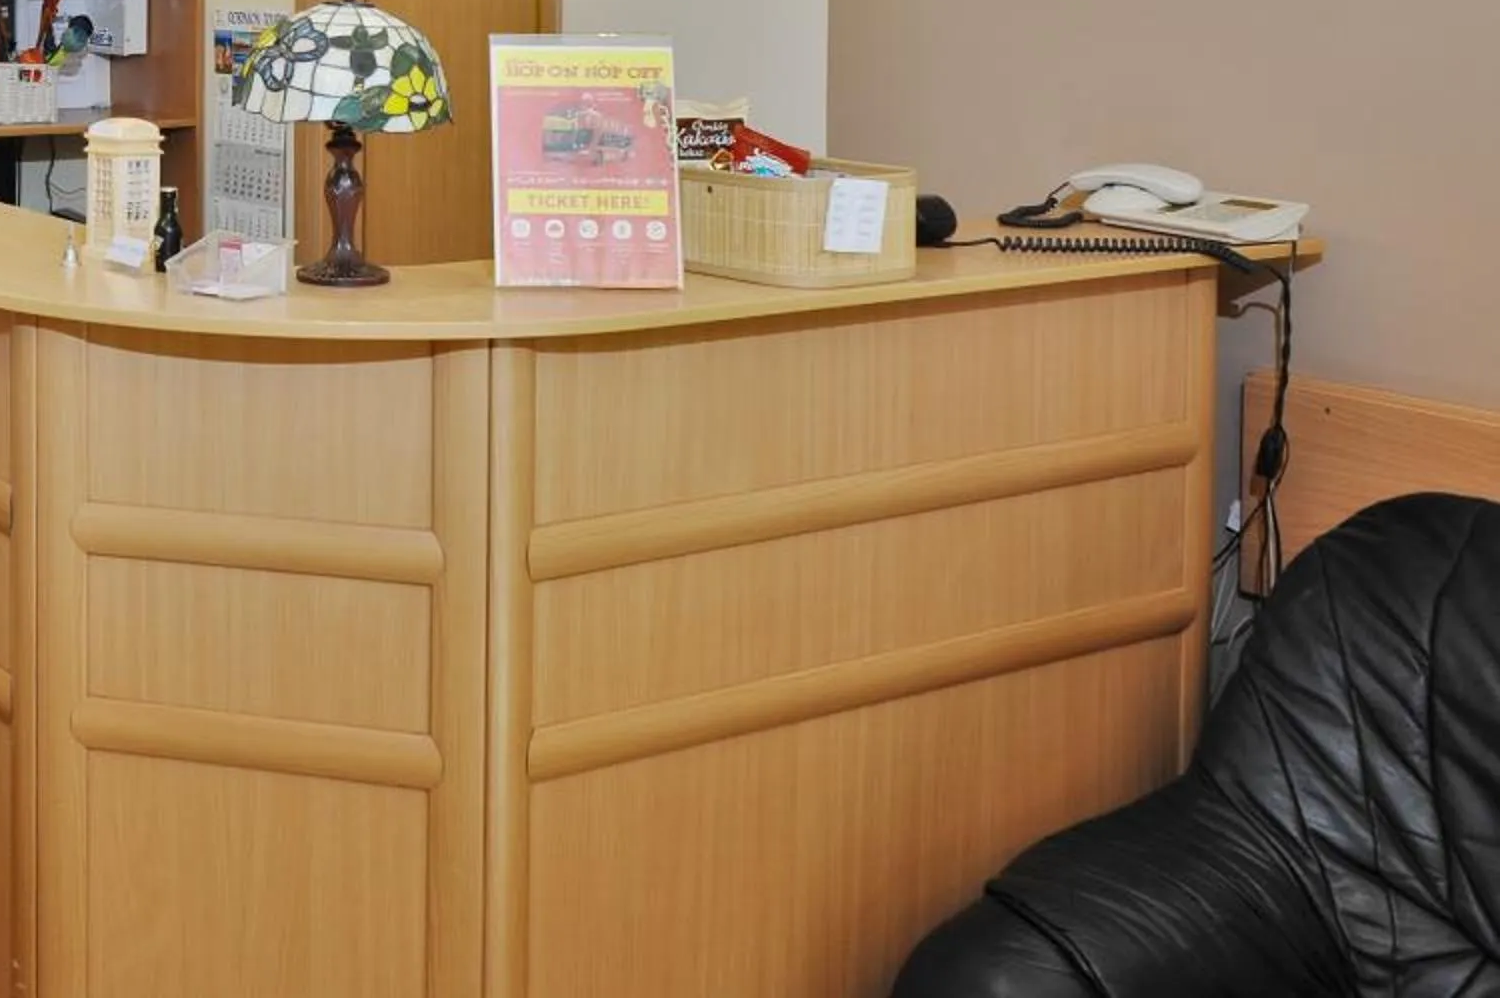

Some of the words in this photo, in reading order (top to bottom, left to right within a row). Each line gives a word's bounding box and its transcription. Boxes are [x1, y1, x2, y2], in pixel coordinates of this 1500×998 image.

[505, 61, 545, 78] HOP
[547, 65, 578, 78] ON
[585, 63, 623, 79] HOP
[627, 66, 664, 80] OFF
[527, 194, 590, 209] TICKET
